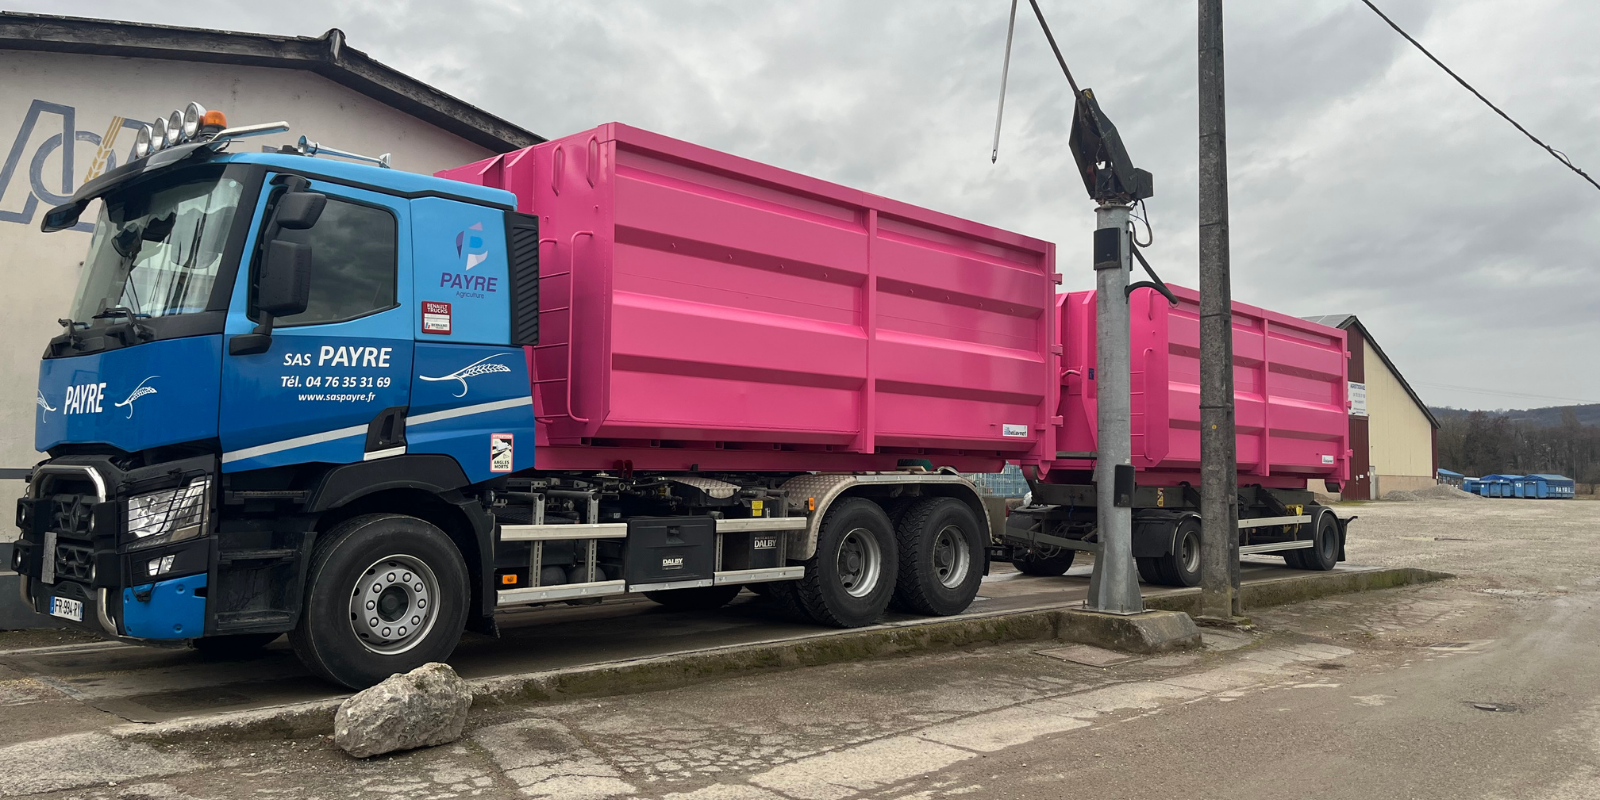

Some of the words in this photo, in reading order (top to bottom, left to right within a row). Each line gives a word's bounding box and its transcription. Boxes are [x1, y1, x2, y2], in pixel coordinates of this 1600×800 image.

[440, 272, 498, 292] PAYRE
[456, 291, 484, 299] Agriculture
[283, 353, 311, 366] SAS
[318, 346, 392, 367] PAYRE
[281, 376, 302, 387] Tél.
[306, 376, 321, 387] 04
[324, 376, 339, 387] 76
[342, 376, 357, 387] 35
[360, 377, 373, 387] 31
[376, 377, 391, 387] 69
[64, 382, 106, 415] PAYRE
[298, 392, 376, 402] www.saspayre.fr
[662, 558, 683, 566] DALBY
